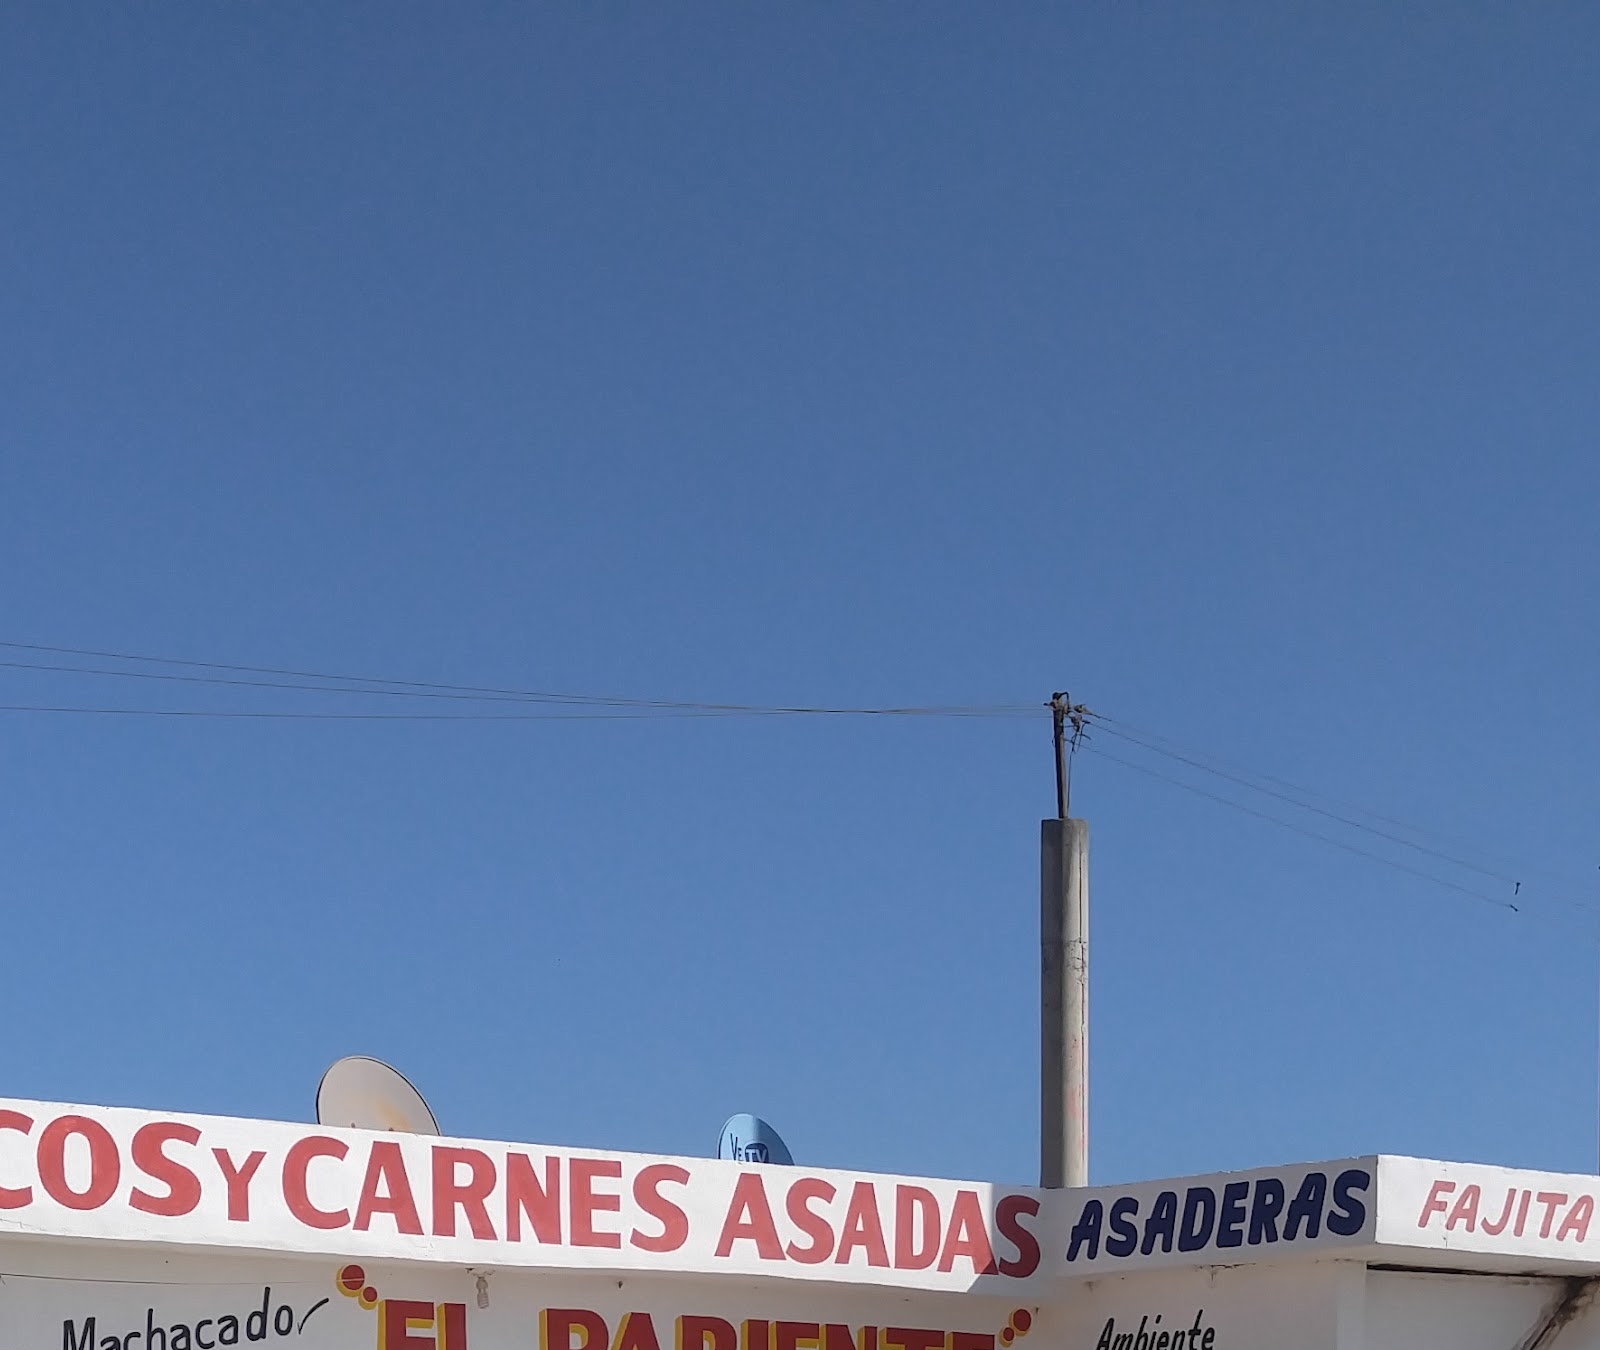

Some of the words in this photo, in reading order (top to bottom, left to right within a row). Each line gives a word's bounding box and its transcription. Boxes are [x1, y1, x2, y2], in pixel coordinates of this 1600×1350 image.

[210, 1147, 267, 1222] Y
[282, 1135, 691, 1254] CARNES
[714, 1172, 1043, 1278] ASADAS
[1066, 1169, 1371, 1262] ASADERAS
[1417, 1179, 1595, 1243] FAJITA
